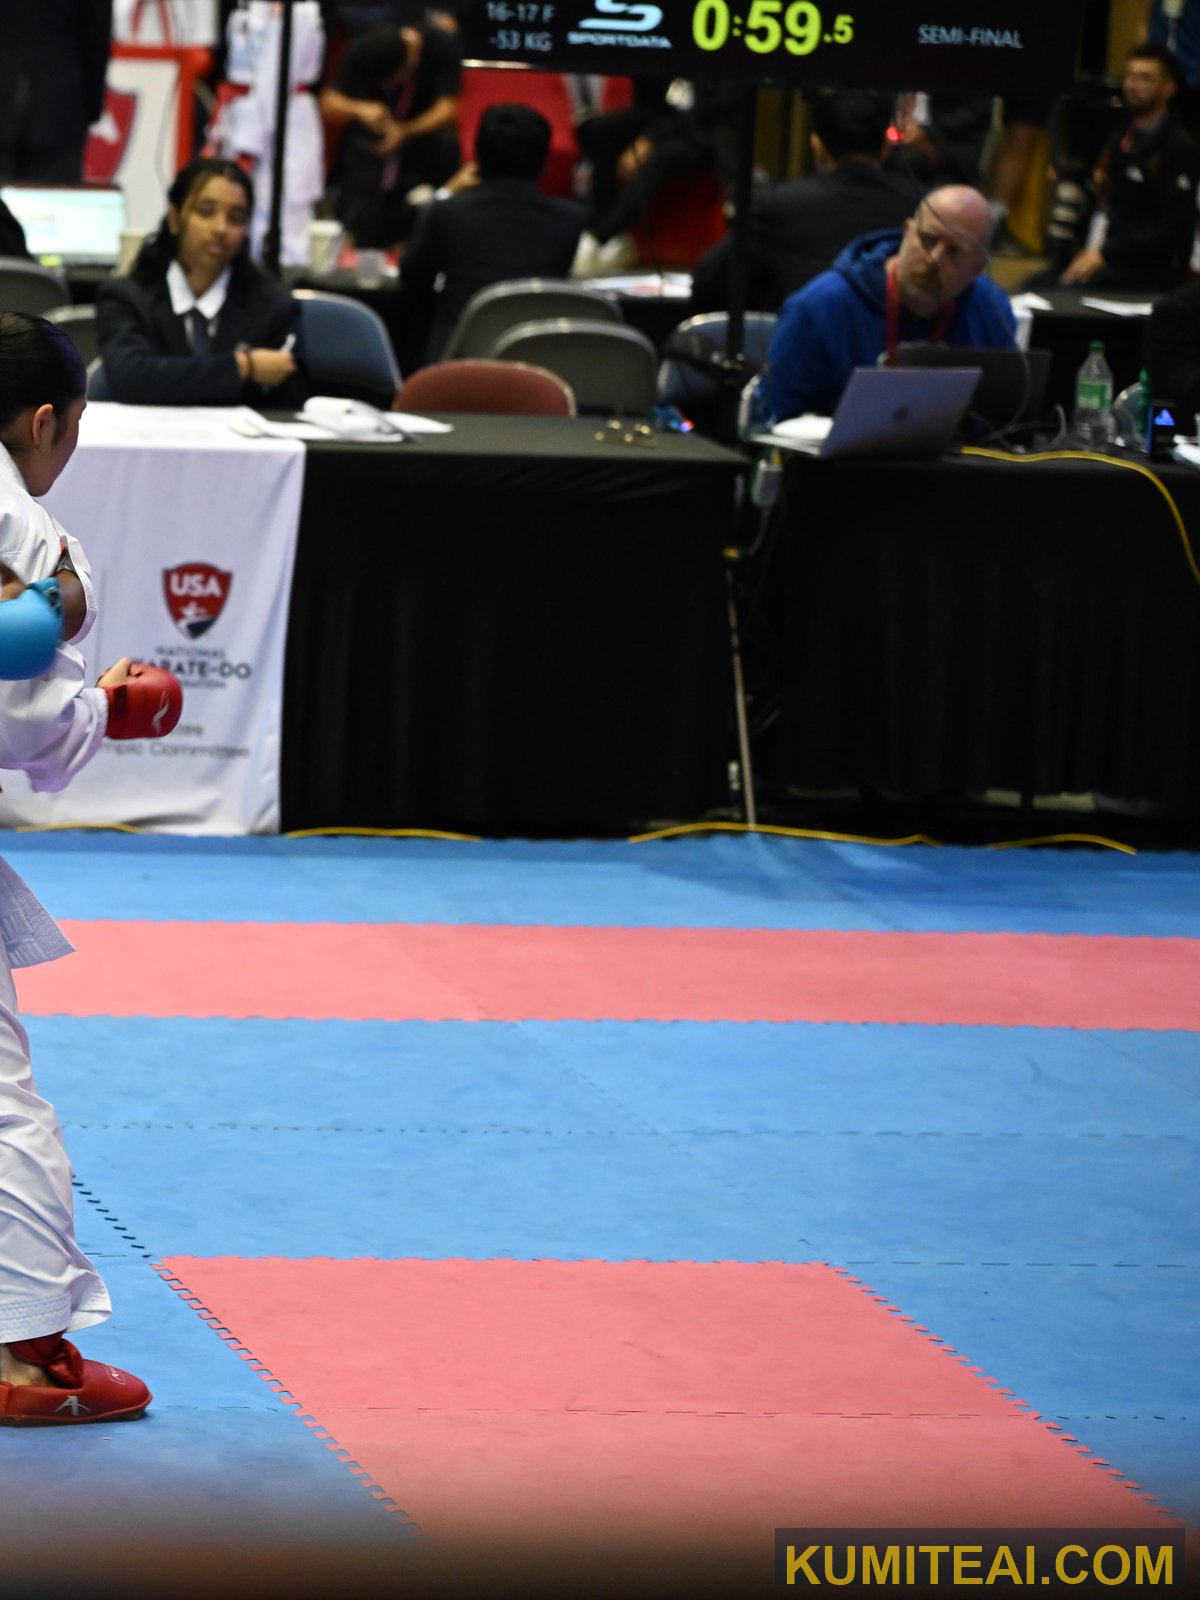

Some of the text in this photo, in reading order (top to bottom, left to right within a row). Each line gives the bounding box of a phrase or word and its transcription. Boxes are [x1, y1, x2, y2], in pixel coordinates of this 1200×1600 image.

[488, 2, 555, 22] 16-17 F
[524, 32, 551, 51] KG
[567, 31, 672, 48] SPORTDATA
[918, 24, 1023, 48] SEMI-FINAL
[171, 573, 221, 596] USA
